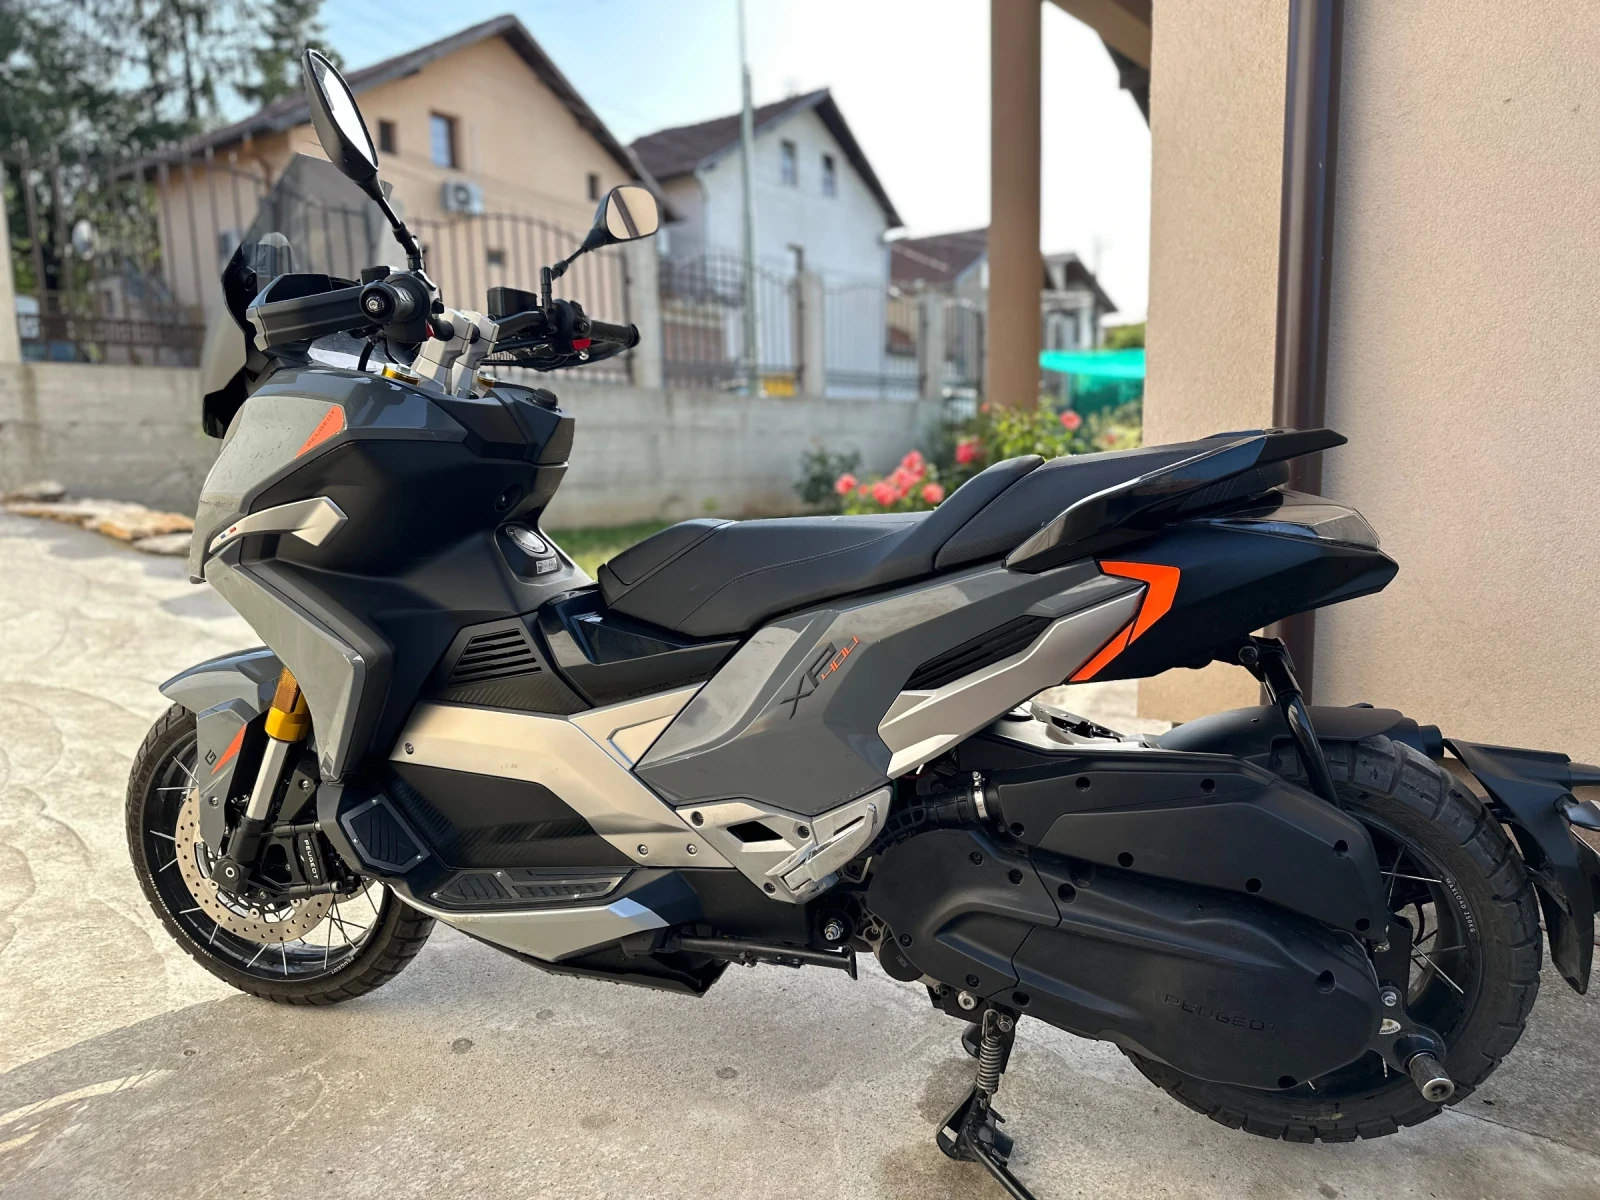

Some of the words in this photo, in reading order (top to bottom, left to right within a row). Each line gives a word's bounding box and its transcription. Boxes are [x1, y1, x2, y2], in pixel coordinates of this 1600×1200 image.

[307, 410, 335, 447] PEUGEOT
[304, 839, 319, 880] PEUGEOT
[155, 890, 170, 914] MAXLOAD
[1445, 877, 1467, 909] MAXLOAD
[331, 956, 355, 975] PEUGEOT
[1164, 993, 1276, 1033] PEUGEOT
